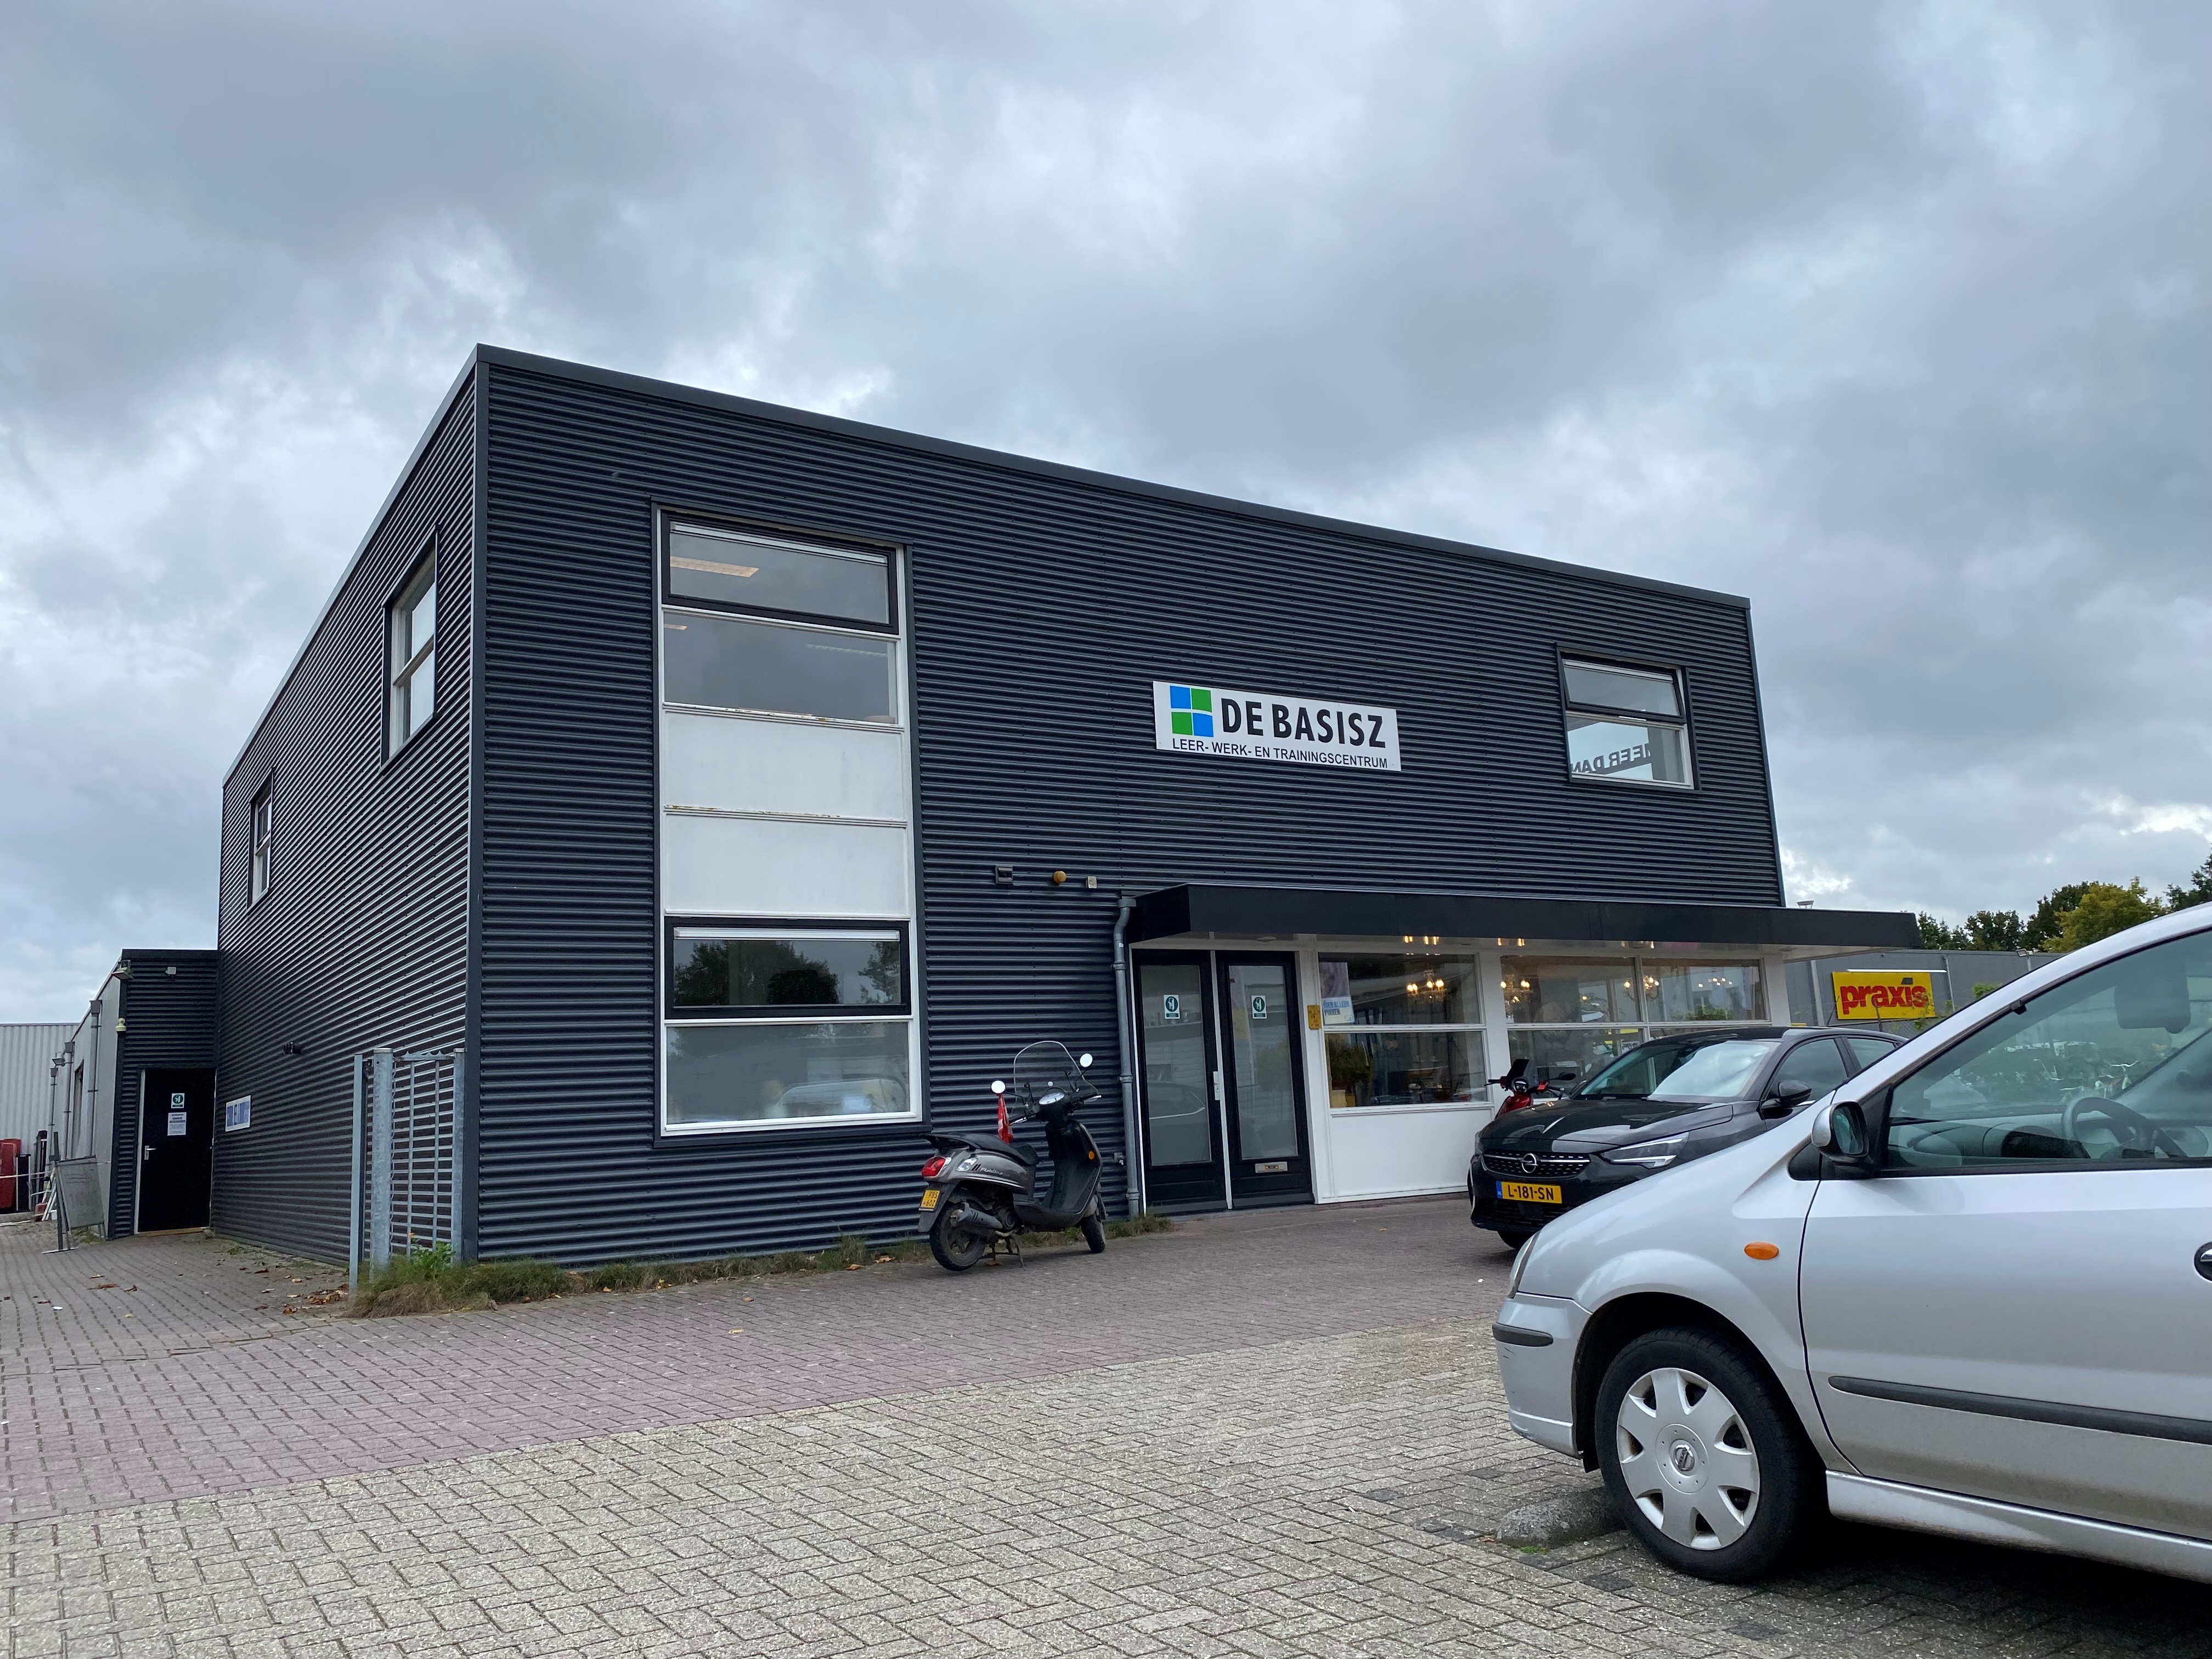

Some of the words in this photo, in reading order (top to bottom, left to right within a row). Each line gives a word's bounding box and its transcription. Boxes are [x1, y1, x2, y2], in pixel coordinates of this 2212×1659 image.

[1221, 697, 1263, 736] DE
[1272, 703, 1386, 748] BASISZ
[1172, 738, 1209, 752] LEER-
[1211, 742, 1251, 755] WERK-
[1255, 746, 1270, 758] EN
[1273, 747, 1387, 769] TRAININGSCENTRUM
[1840, 977, 1929, 1015] praxis
[1508, 1184, 1554, 1200] L-181-SN
